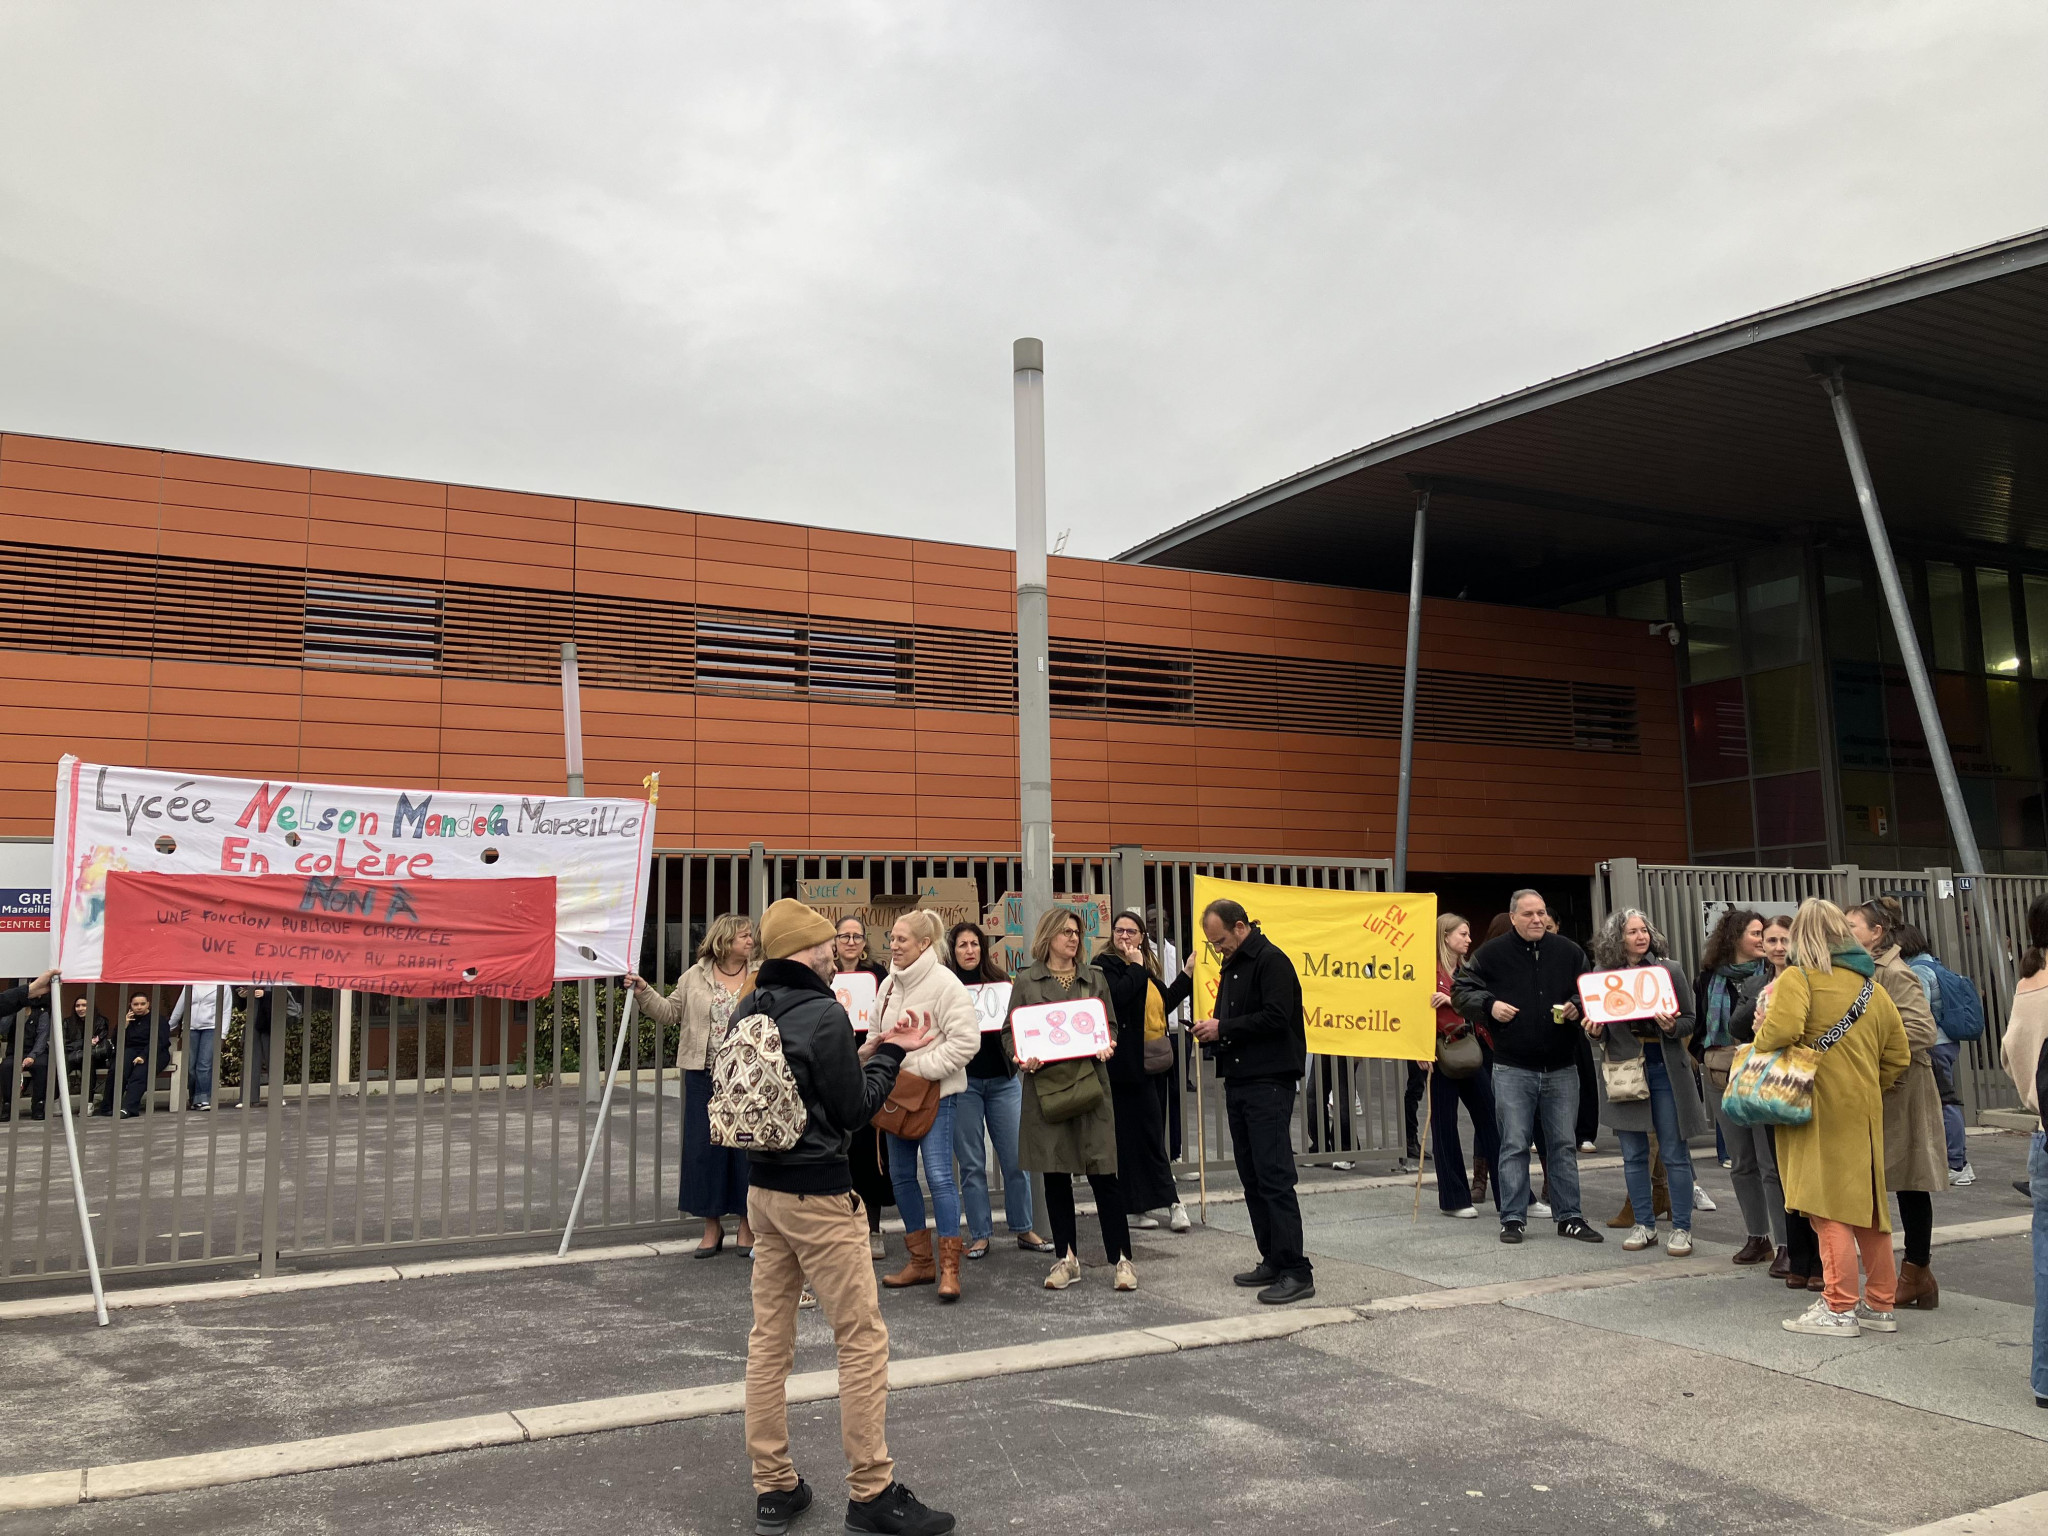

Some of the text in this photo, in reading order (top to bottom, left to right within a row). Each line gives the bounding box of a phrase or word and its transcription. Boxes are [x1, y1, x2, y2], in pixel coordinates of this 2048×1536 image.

[96, 767, 215, 836] Lycée
[392, 792, 510, 838] Mandela
[221, 836, 270, 873] En
[157, 909, 191, 924] UNE
[1385, 904, 1408, 926] EN
[202, 937, 238, 954] UNE
[255, 942, 351, 964] EDUCATION
[364, 951, 385, 967] AU
[1302, 952, 1416, 981] Mandela
[1584, 970, 1674, 1017] -80 H
[1301, 1005, 1401, 1032] Marseille
[760, 1506, 776, 1514] FILA
